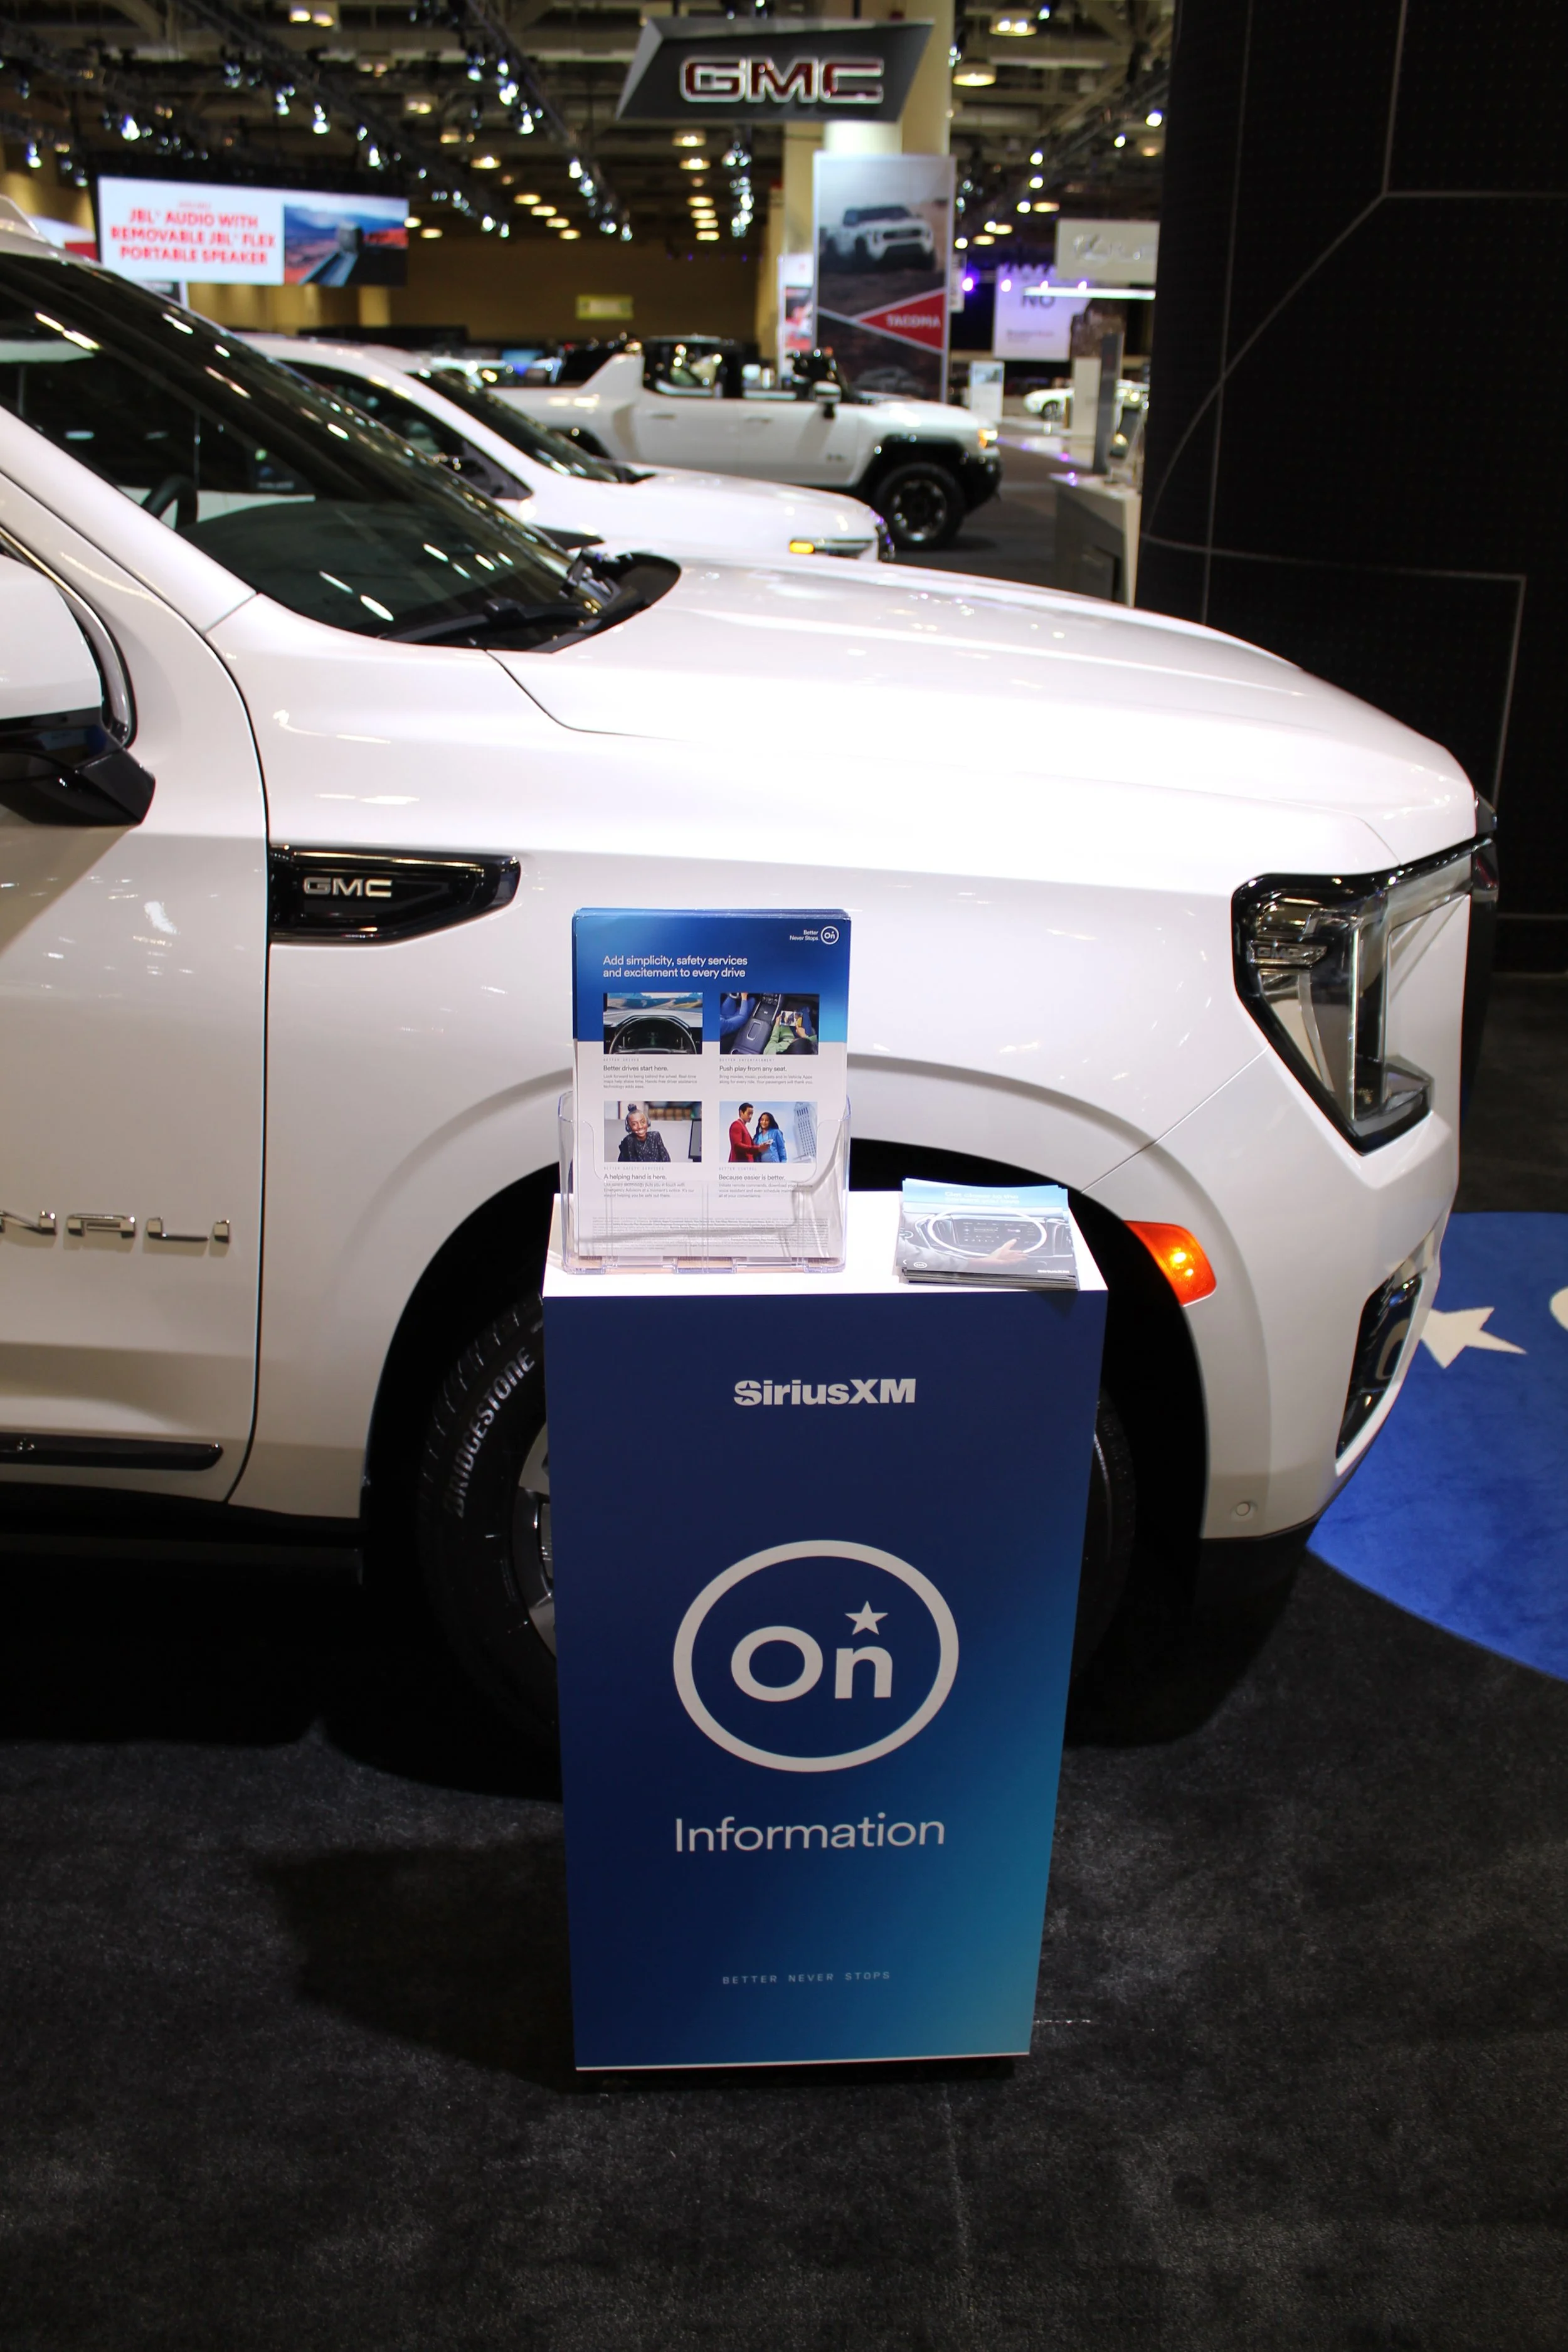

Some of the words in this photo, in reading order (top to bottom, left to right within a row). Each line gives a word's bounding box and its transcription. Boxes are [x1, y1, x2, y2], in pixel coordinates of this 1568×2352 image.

[680, 56, 885, 105] GMC
[165, 211, 215, 226] AUDIO
[219, 213, 258, 228] WITH
[111, 226, 204, 245] REMOVABLE
[119, 246, 197, 262] PORTABLE
[202, 249, 267, 265] SPEAKER
[886, 315, 941, 328] TACOMA
[303, 877, 393, 898] GMC
[603, 955, 623, 965] Add
[627, 955, 674, 968] simplicity,
[676, 955, 706, 968] safety
[708, 956, 748, 966] services
[603, 968, 622, 978] and
[624, 968, 678, 978] excitement
[680, 968, 691, 978] to
[692, 970, 719, 980] every
[721, 968, 746, 978] drive
[733, 1378, 917, 1407] SiriusXM
[443, 1347, 536, 1518] BRIDGESTONE
[731, 1625, 893, 1702] On
[675, 1812, 946, 1853] Information
[723, 1974, 778, 1984] BETTER
[788, 1973, 833, 1983] NEVER
[845, 1971, 891, 1981] STOPS
